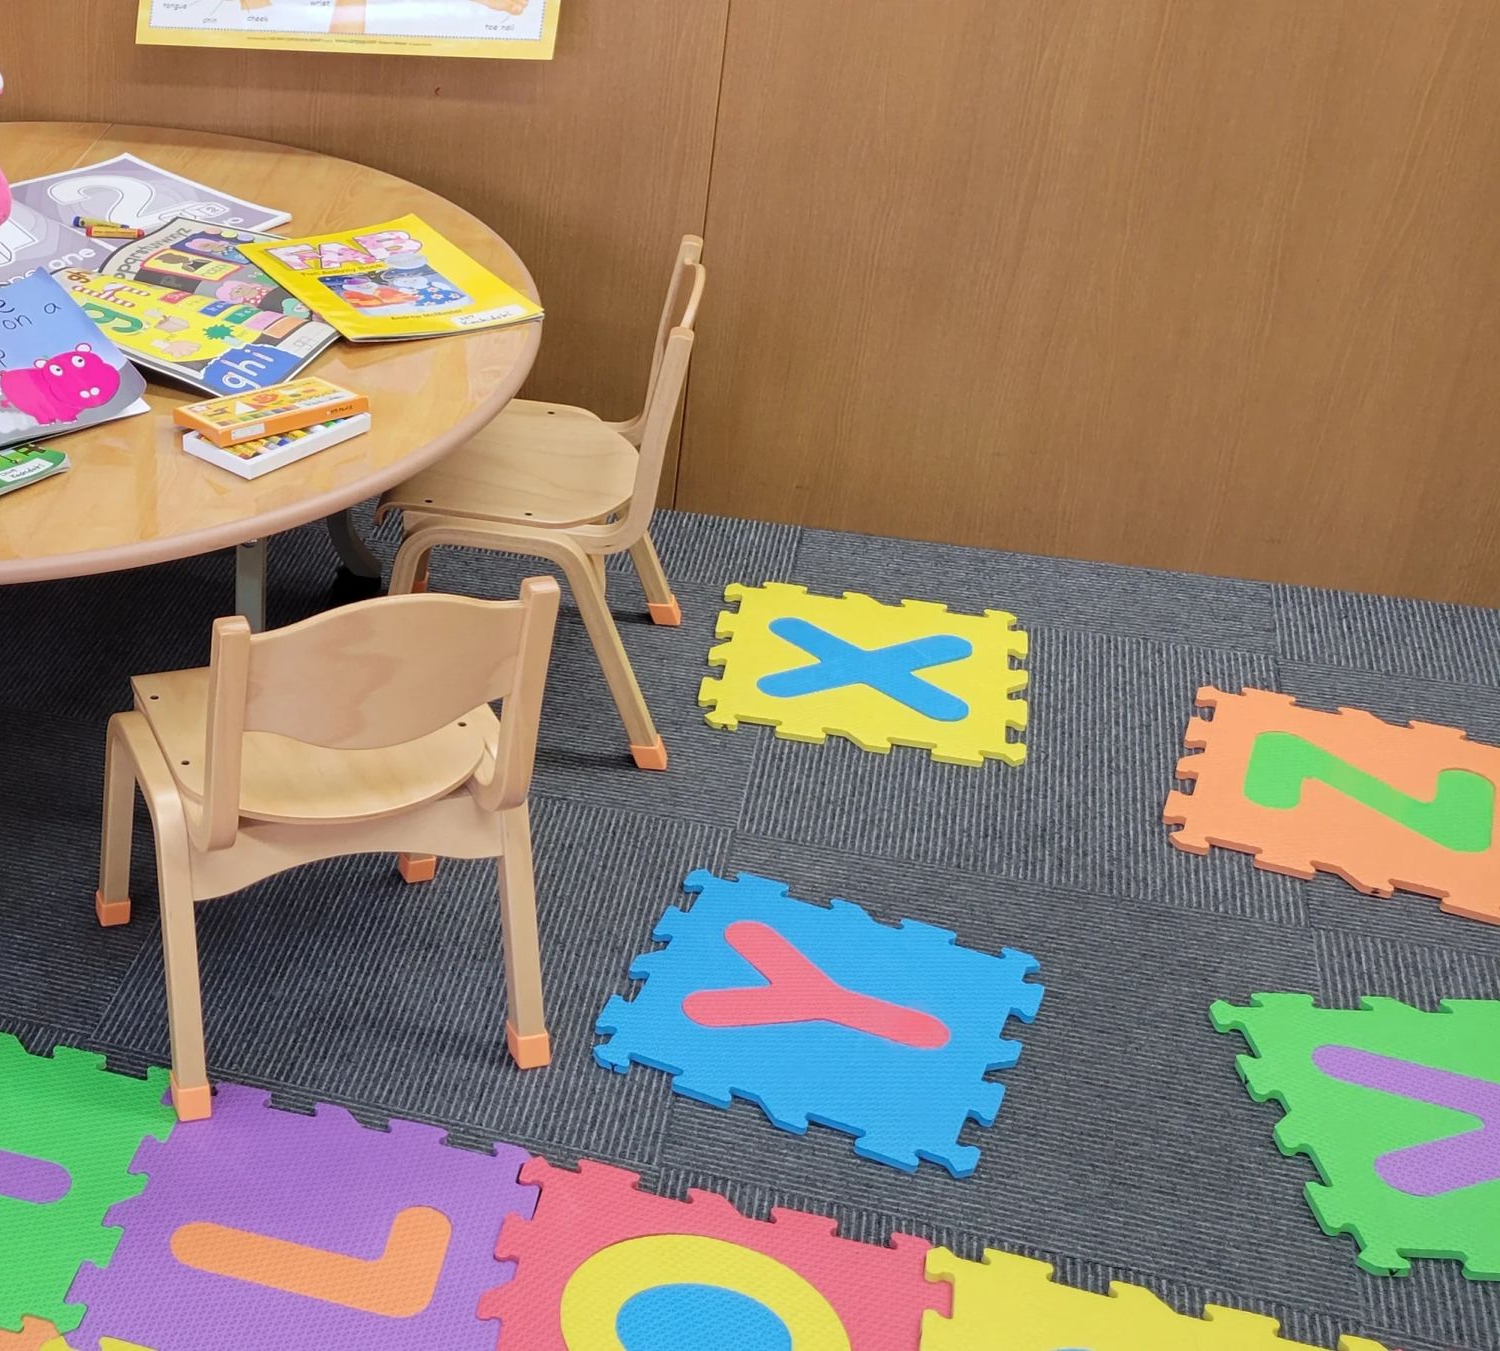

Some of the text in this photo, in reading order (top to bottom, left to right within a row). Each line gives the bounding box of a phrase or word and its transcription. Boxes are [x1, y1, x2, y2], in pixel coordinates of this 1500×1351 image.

[49, 247, 96, 271] one
[265, 230, 423, 271] FAB
[2, 313, 32, 331] on
[43, 302, 61, 316] a
[221, 348, 276, 391] ghi
[756, 617, 976, 722] X
[682, 920, 953, 1053] Y
[170, 1206, 452, 1320] L
